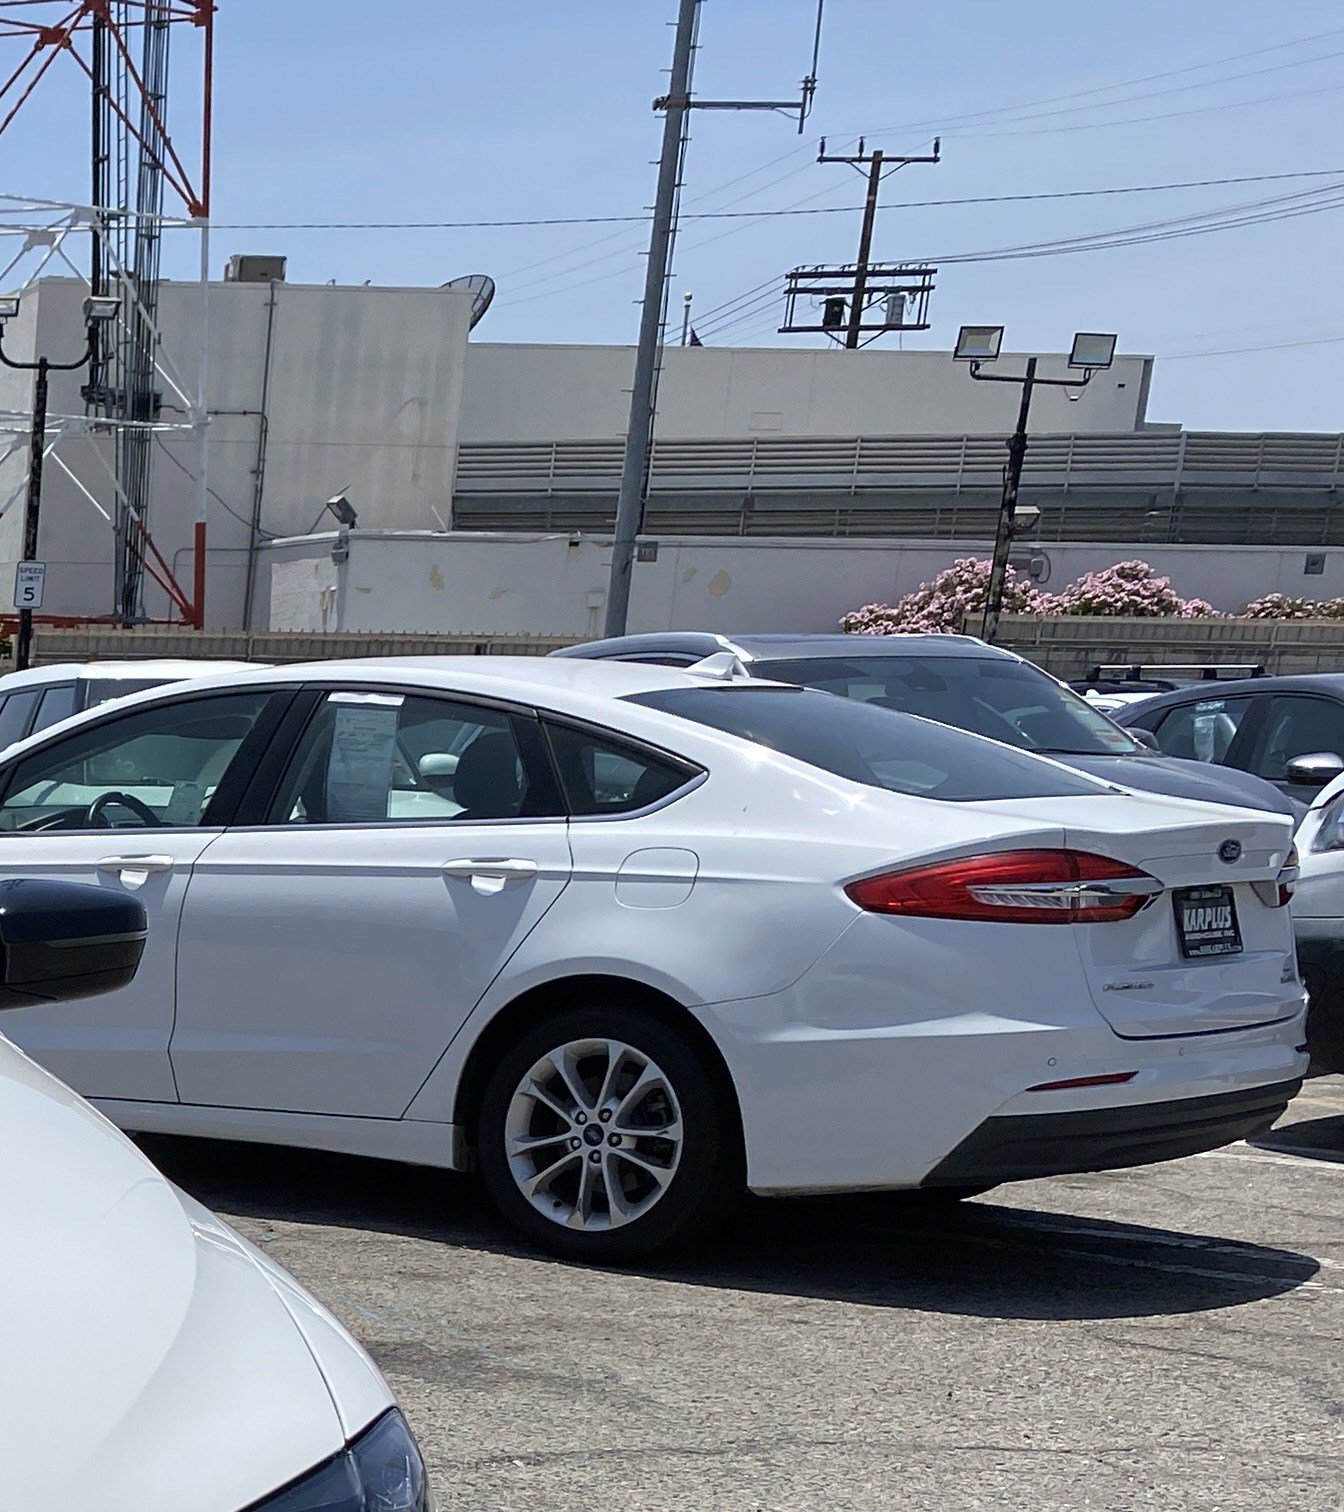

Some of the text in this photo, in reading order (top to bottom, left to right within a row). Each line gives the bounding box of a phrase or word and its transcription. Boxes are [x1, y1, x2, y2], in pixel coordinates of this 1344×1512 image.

[19, 567, 44, 575] SPEED
[20, 575, 40, 583] LIMIT
[23, 586, 35, 602] 5
[1183, 905, 1232, 932] KARPLUS
